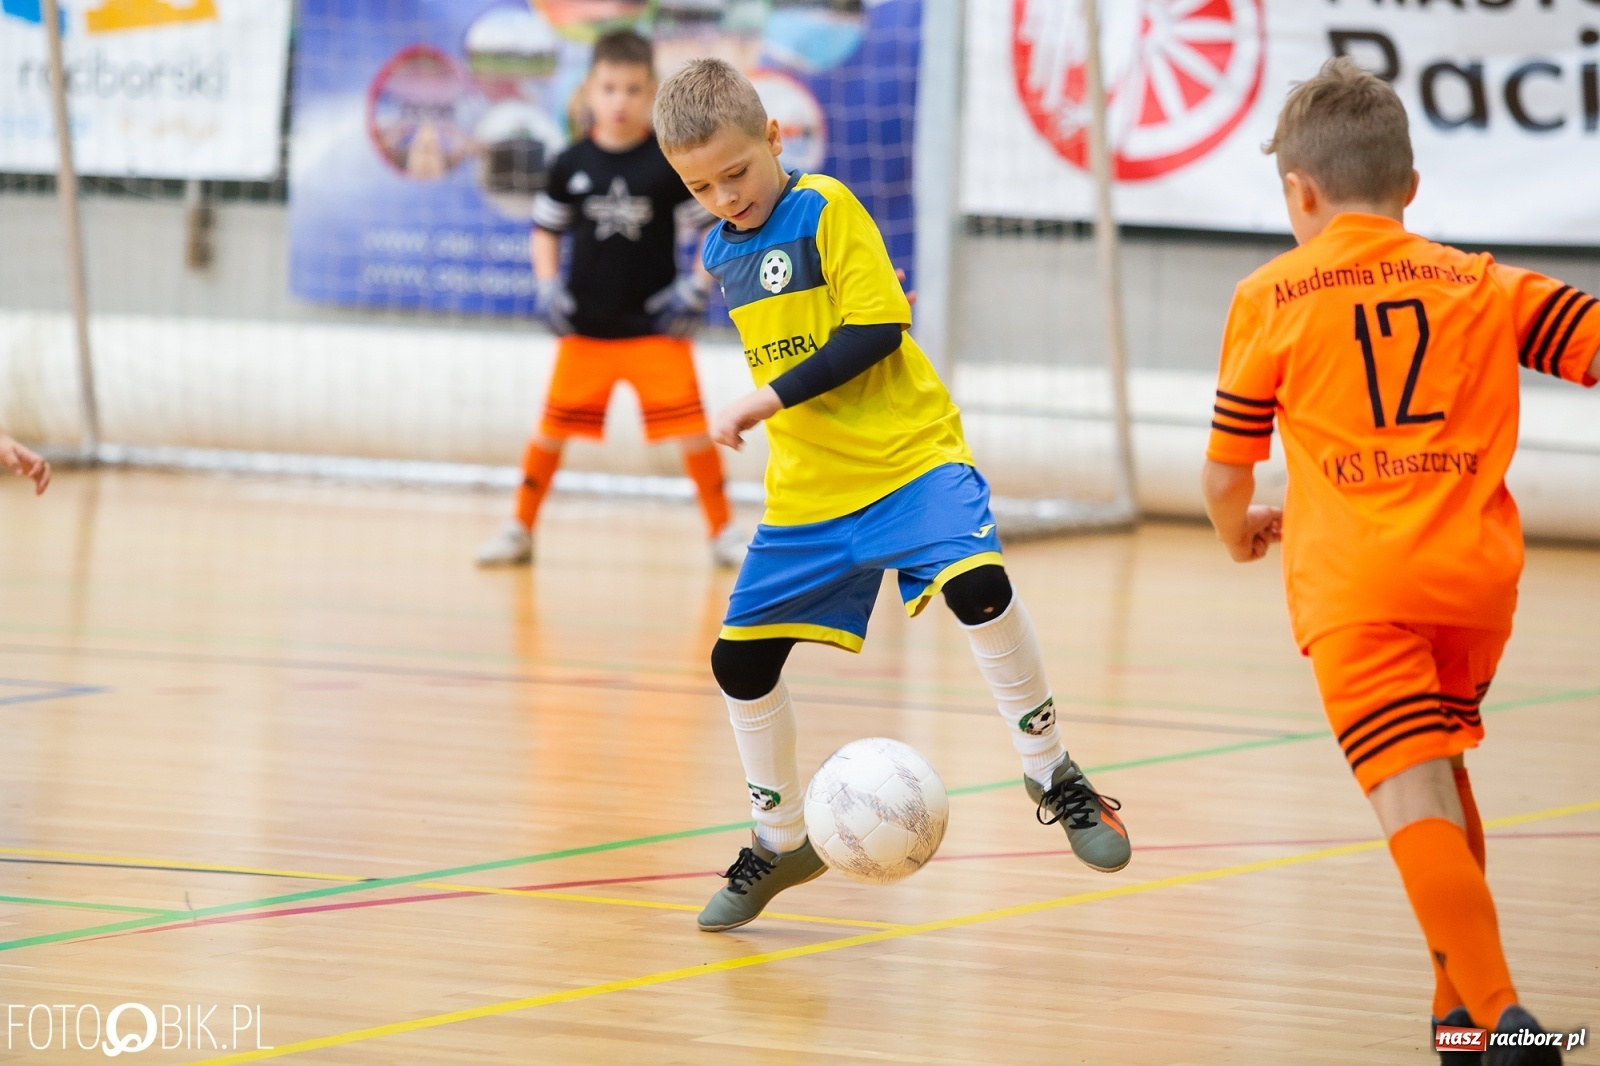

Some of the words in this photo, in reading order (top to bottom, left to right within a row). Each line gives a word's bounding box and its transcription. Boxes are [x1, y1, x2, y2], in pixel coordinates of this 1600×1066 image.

[1273, 262, 1375, 309] Akademia
[762, 333, 819, 363] TERRA
[1353, 297, 1446, 429] 12
